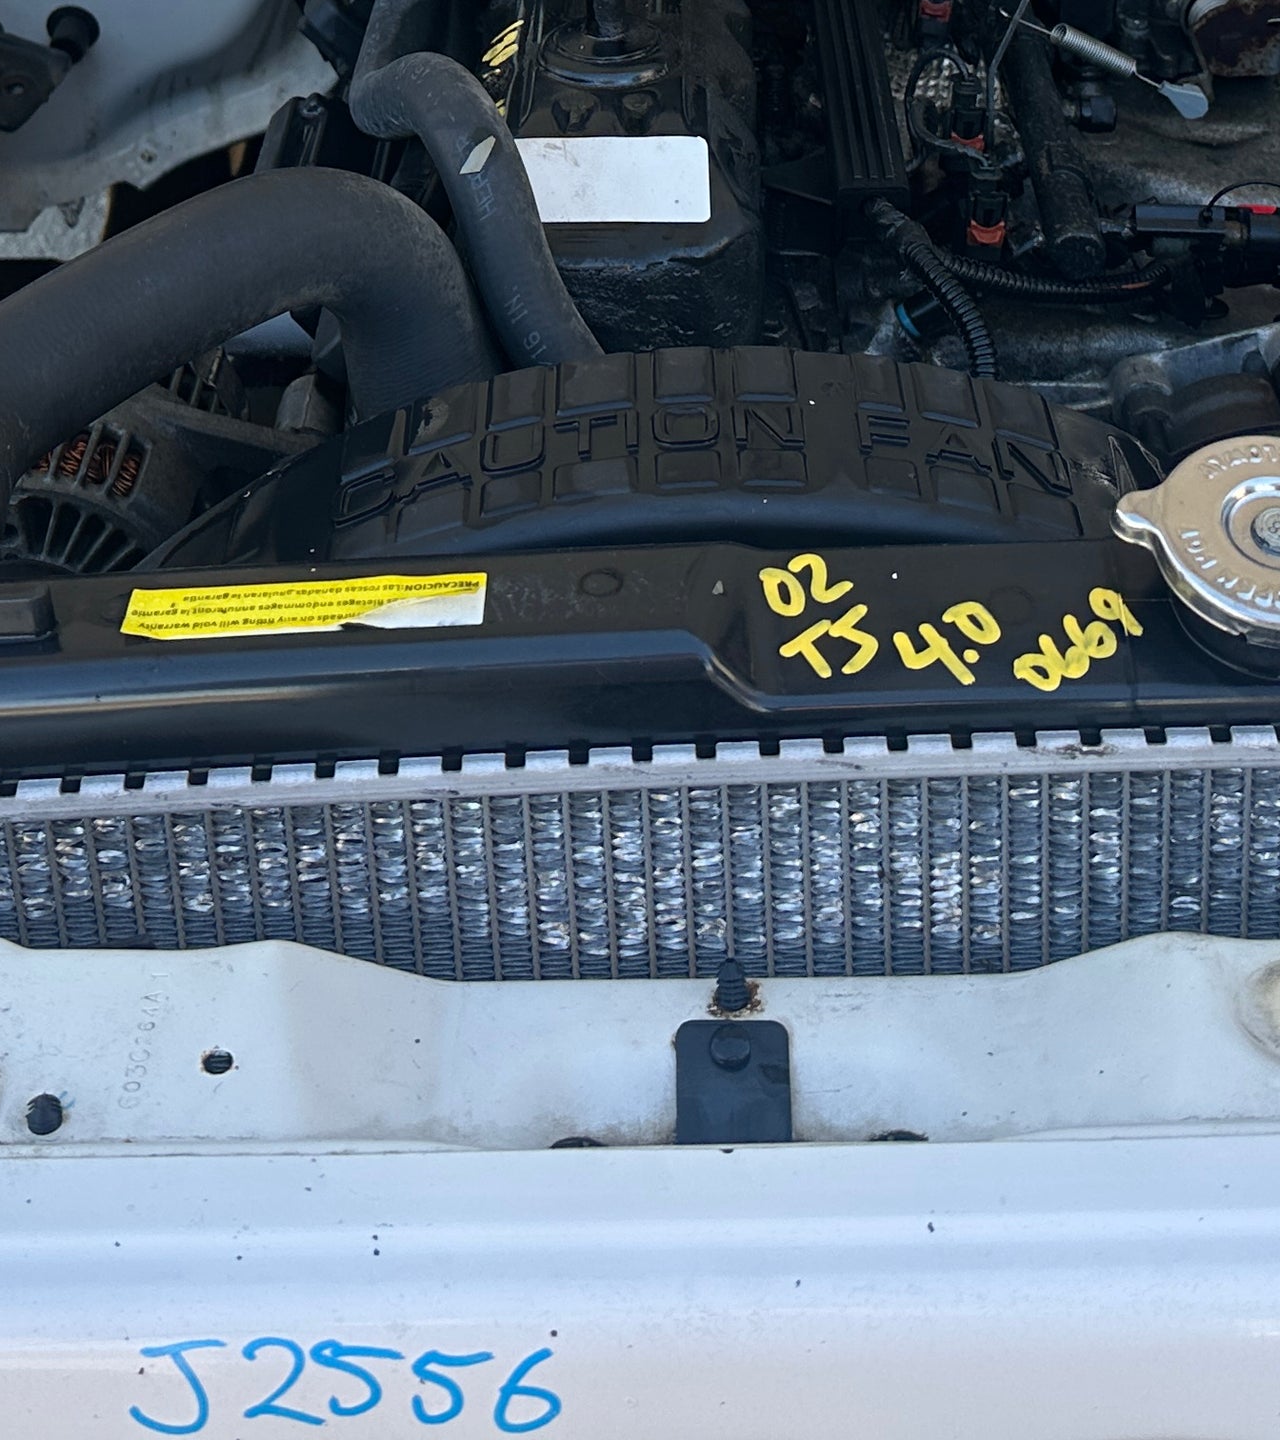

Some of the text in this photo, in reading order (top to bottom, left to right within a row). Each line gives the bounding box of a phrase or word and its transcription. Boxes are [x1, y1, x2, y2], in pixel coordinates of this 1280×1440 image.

[333, 407, 1074, 527] CAUTION FAN
[760, 553, 852, 617] 02
[892, 601, 1001, 686] 4.0
[1013, 586, 1144, 692] 0669
[128, 1337, 562, 1436] J2556
